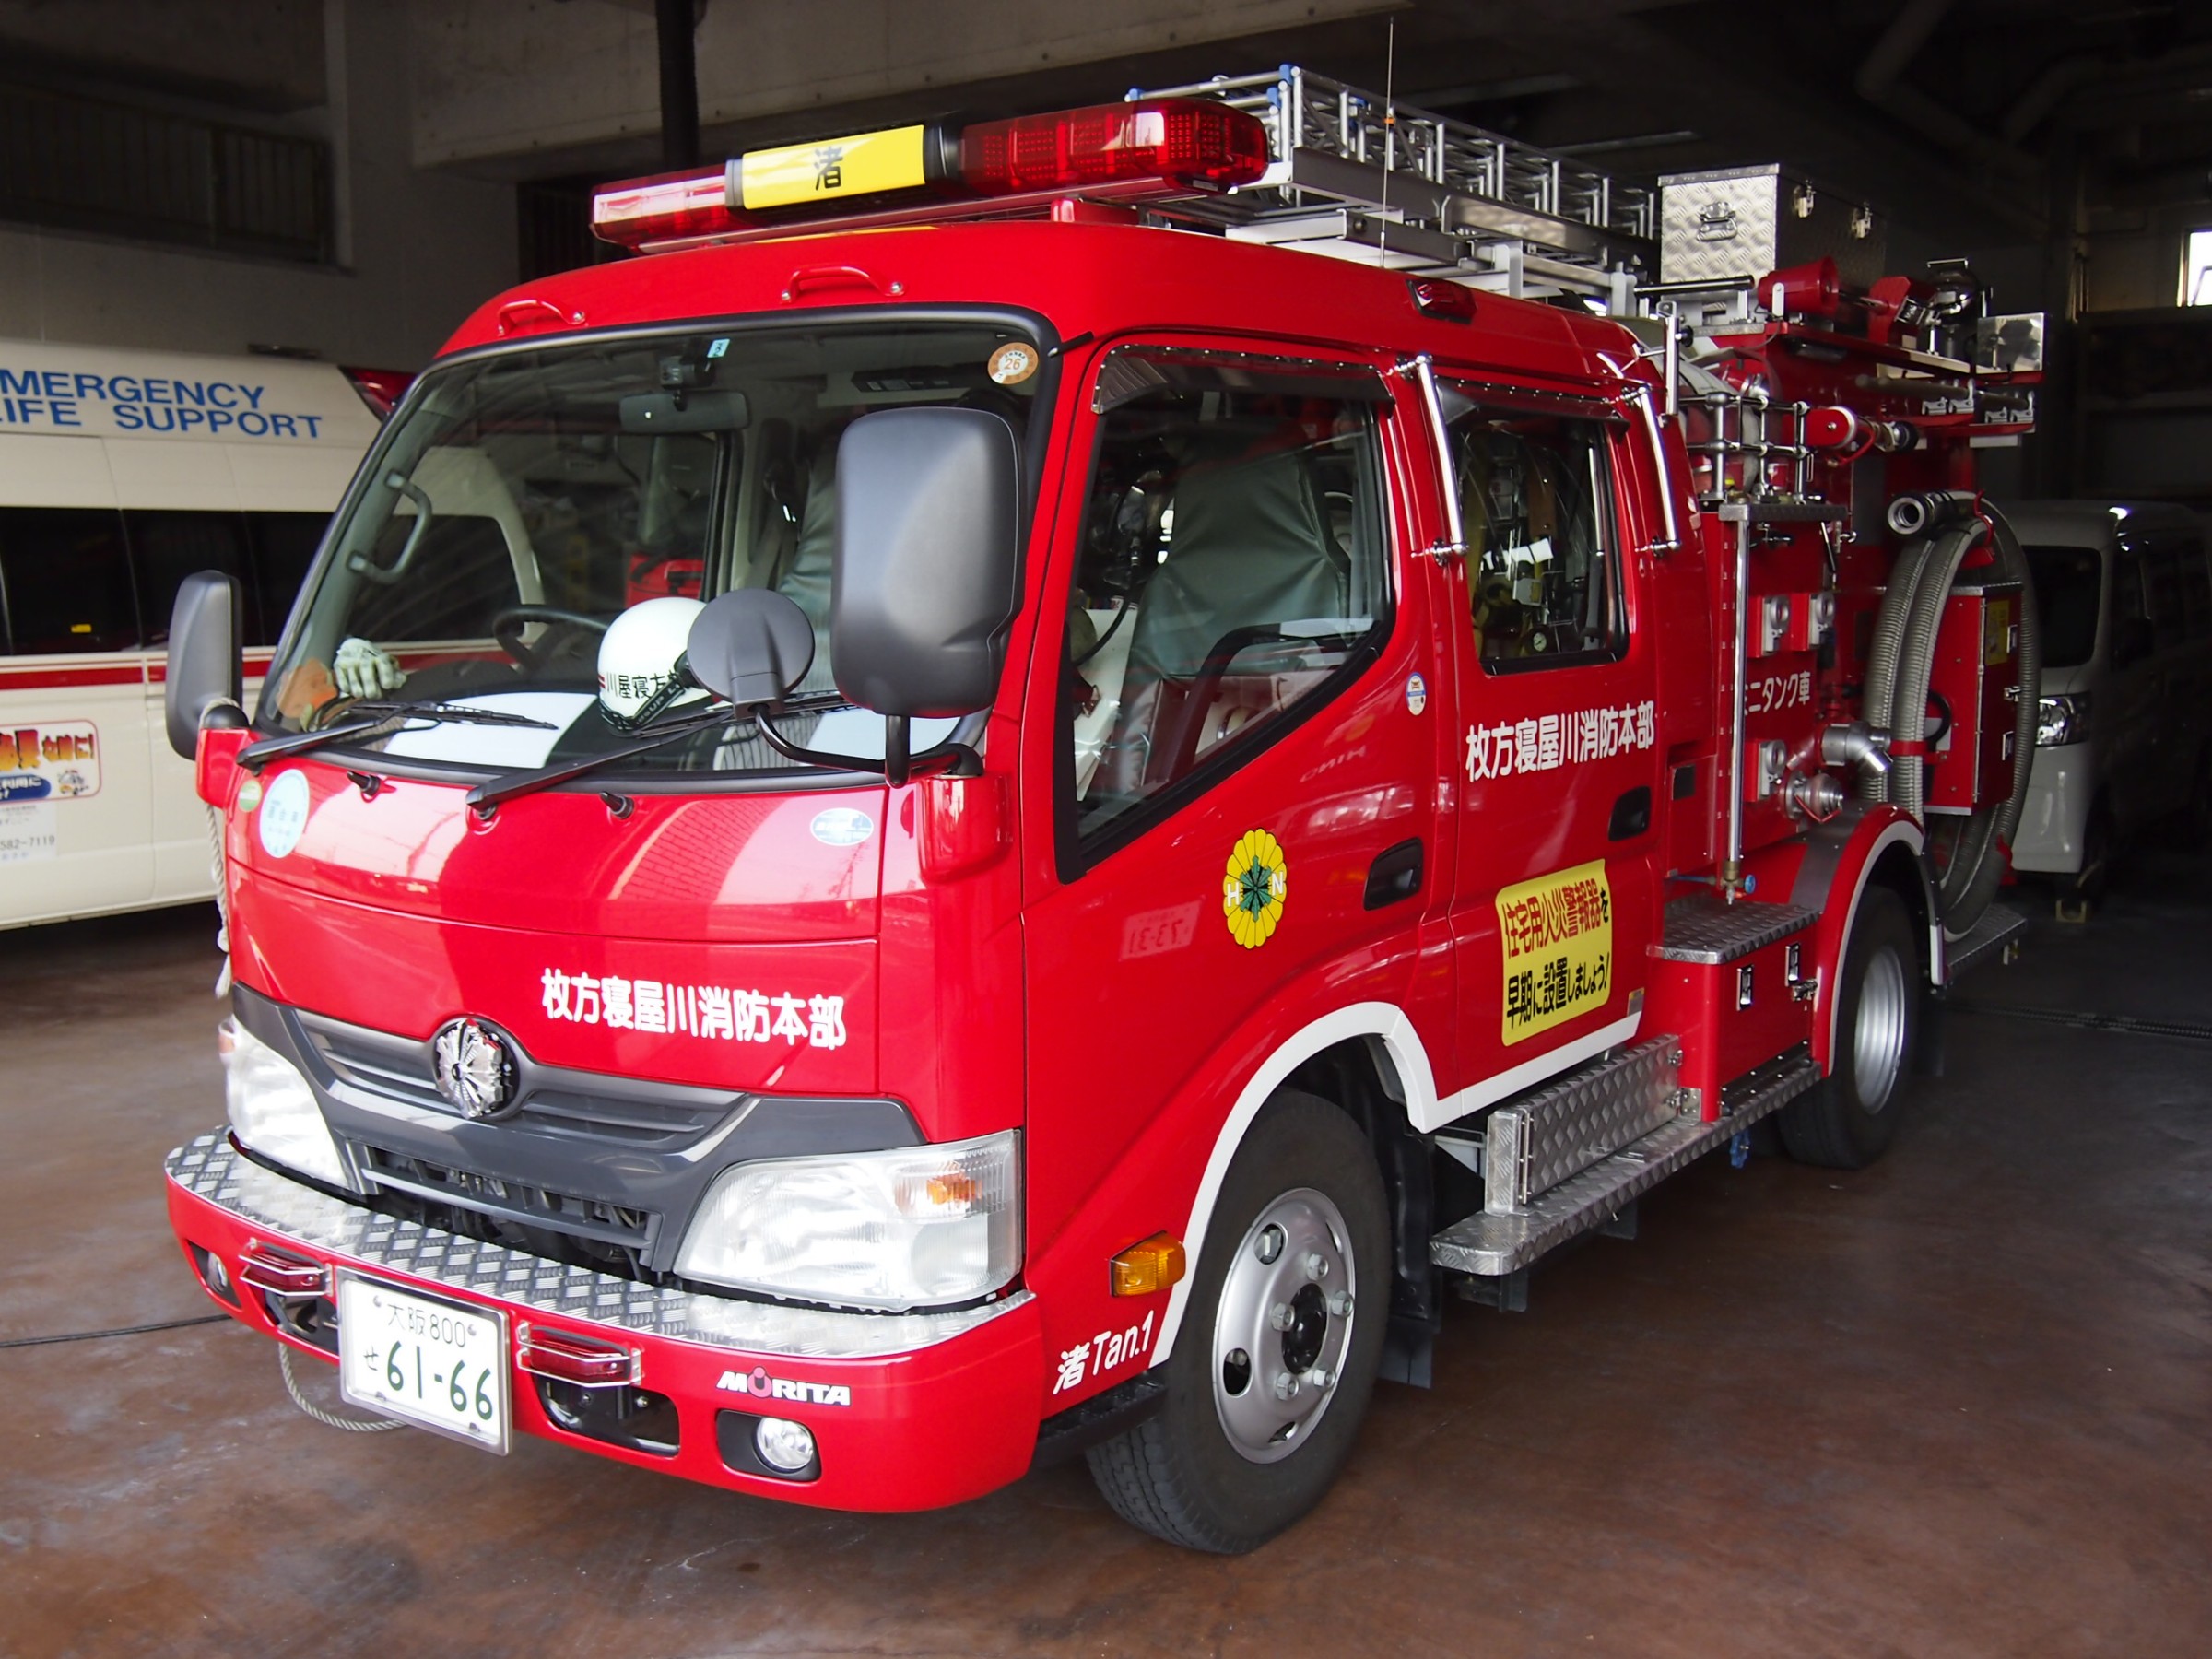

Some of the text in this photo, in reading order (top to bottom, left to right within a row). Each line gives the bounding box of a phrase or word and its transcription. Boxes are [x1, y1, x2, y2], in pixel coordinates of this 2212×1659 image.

[814, 146, 843, 191] 渚
[0, 369, 265, 409] MERGENCY
[0, 397, 322, 438] IFE SUPPORT
[1465, 700, 1654, 782] 枚方寝屋川消防本部
[1227, 871, 1285, 908] H N
[1501, 878, 1609, 959] 住宅用火災警報器を
[541, 968, 846, 1050] 枚方寝屋川消防本部
[363, 1340, 493, 1421] せ 61-66
[716, 1366, 851, 1406] MORITA
